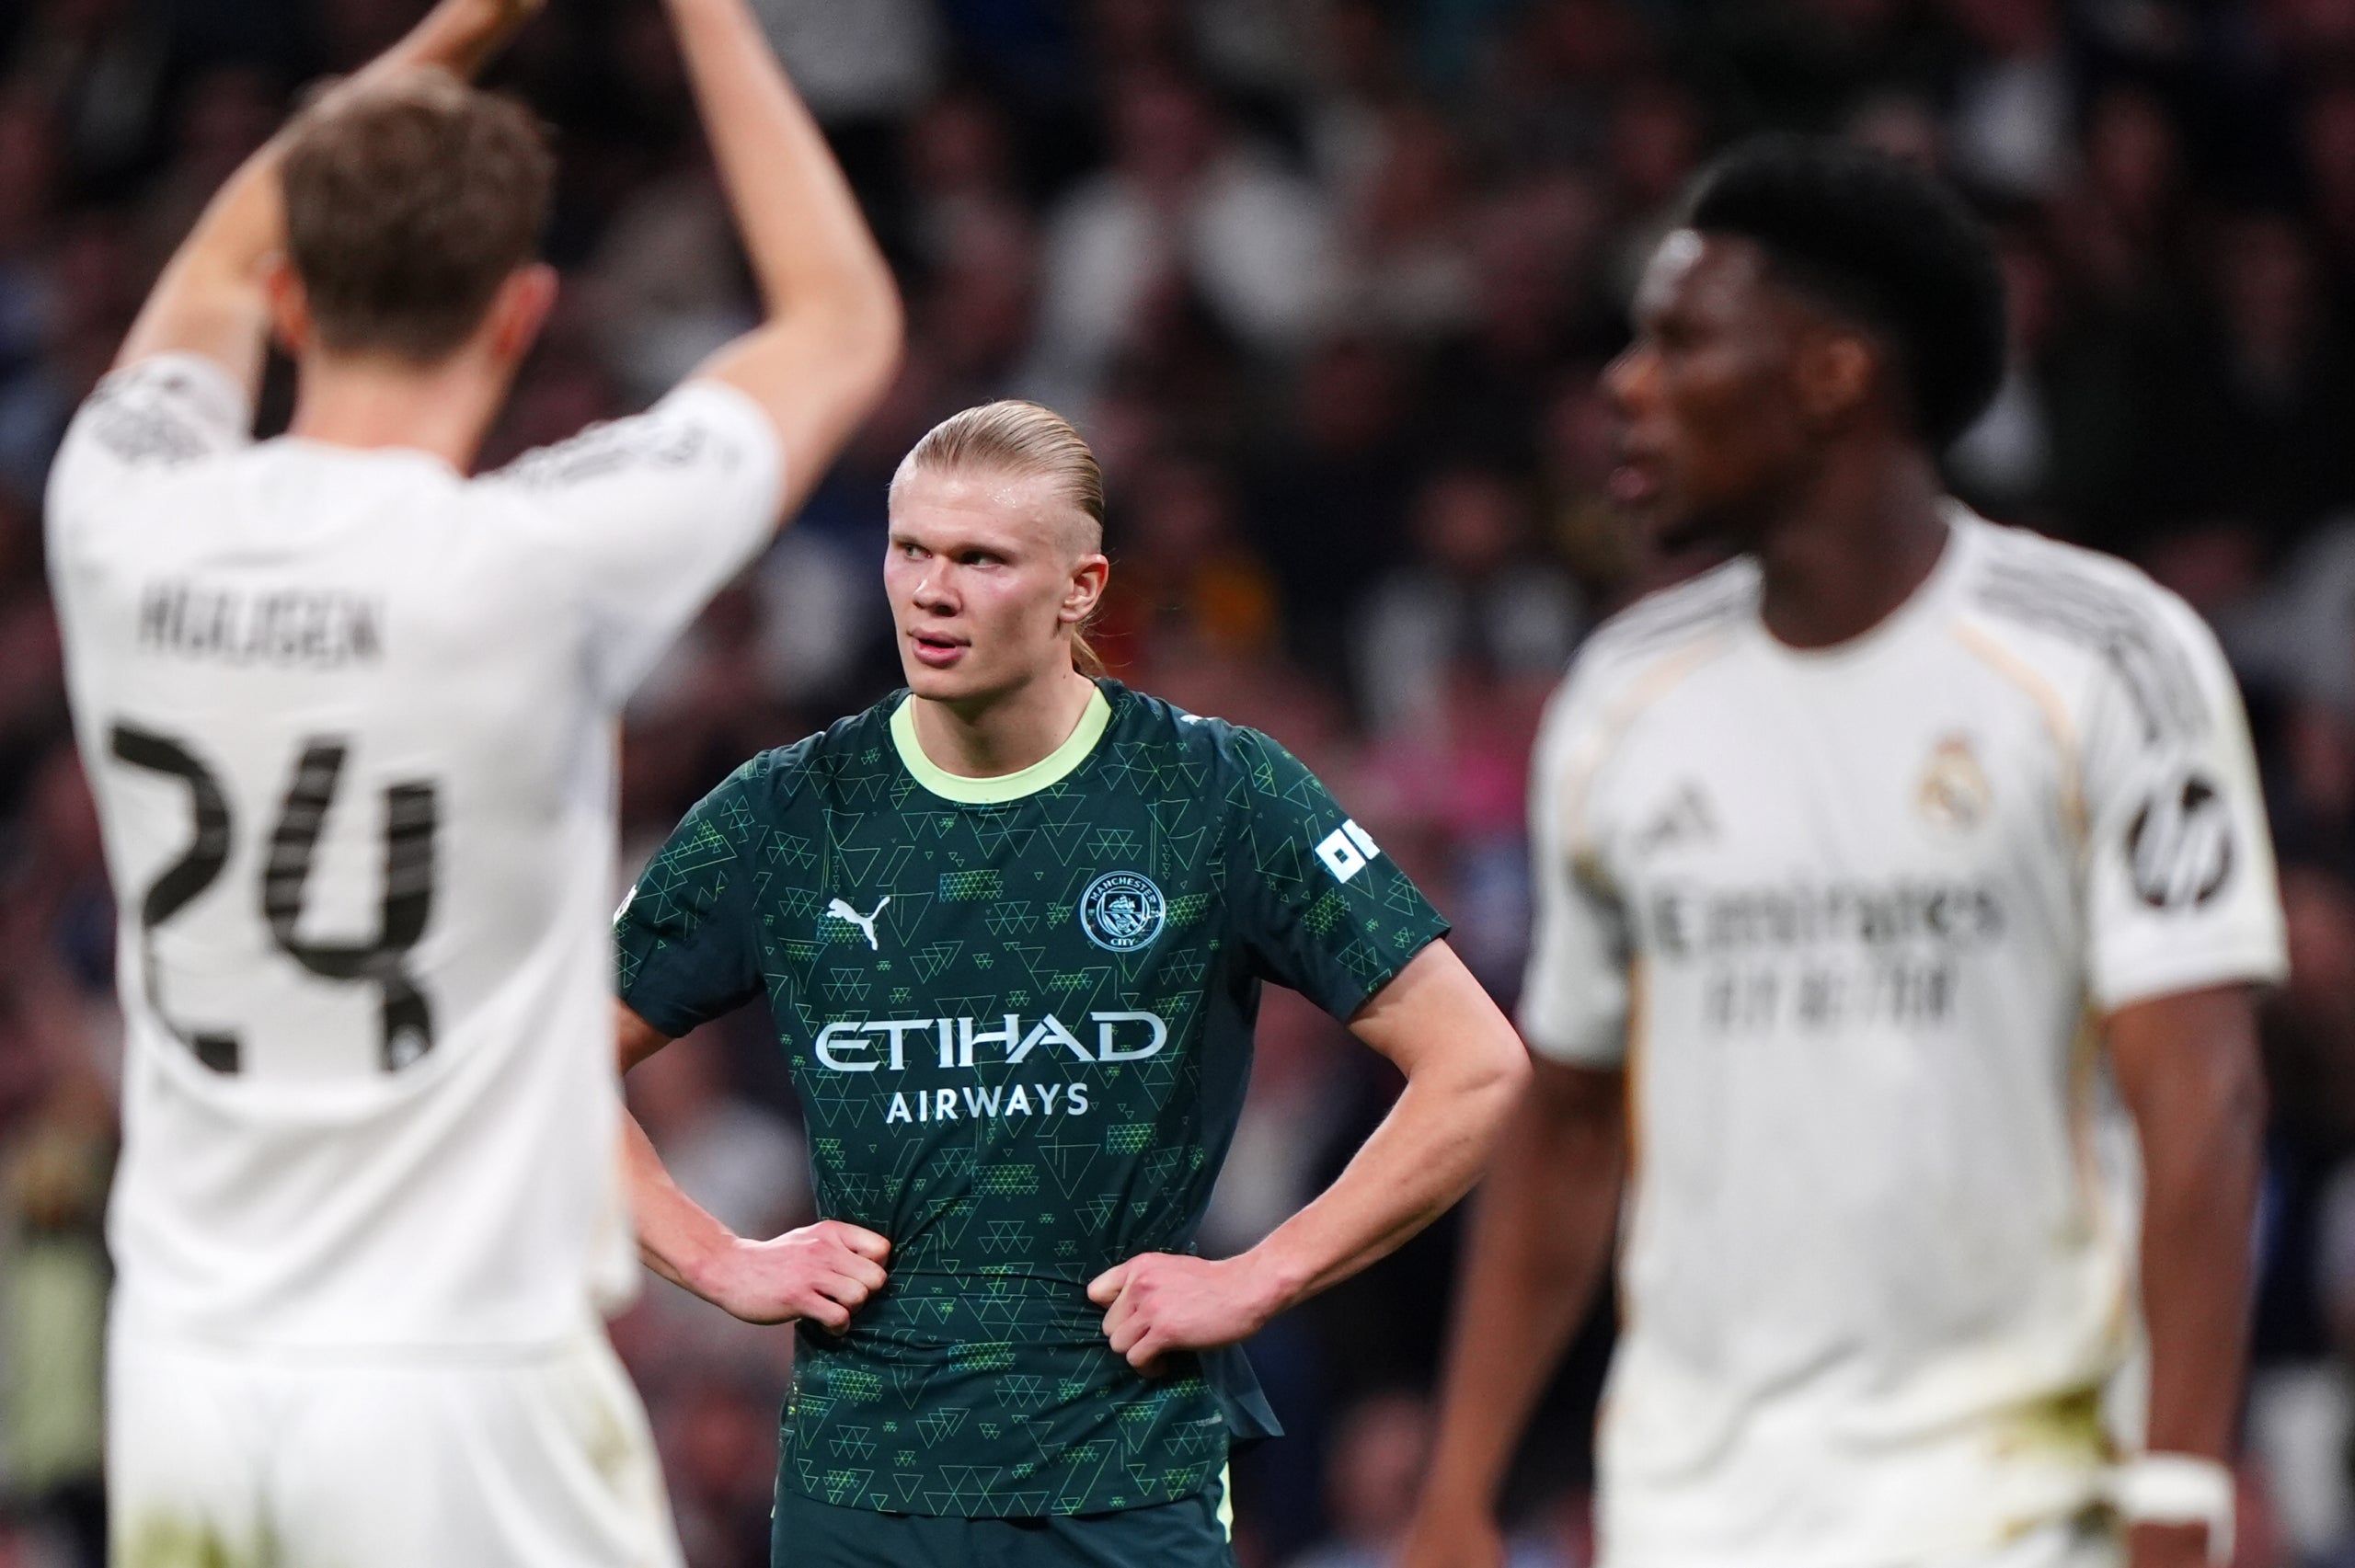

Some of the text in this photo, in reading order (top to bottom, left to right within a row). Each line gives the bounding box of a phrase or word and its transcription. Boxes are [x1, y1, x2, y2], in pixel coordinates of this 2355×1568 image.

[109, 721, 438, 1074] 24
[1090, 876, 1157, 903] MANCHESTER
[1110, 938, 1135, 946] CITY
[815, 1011, 1168, 1072] ETIHAD
[886, 1082, 1089, 1124] AIRWAYS
